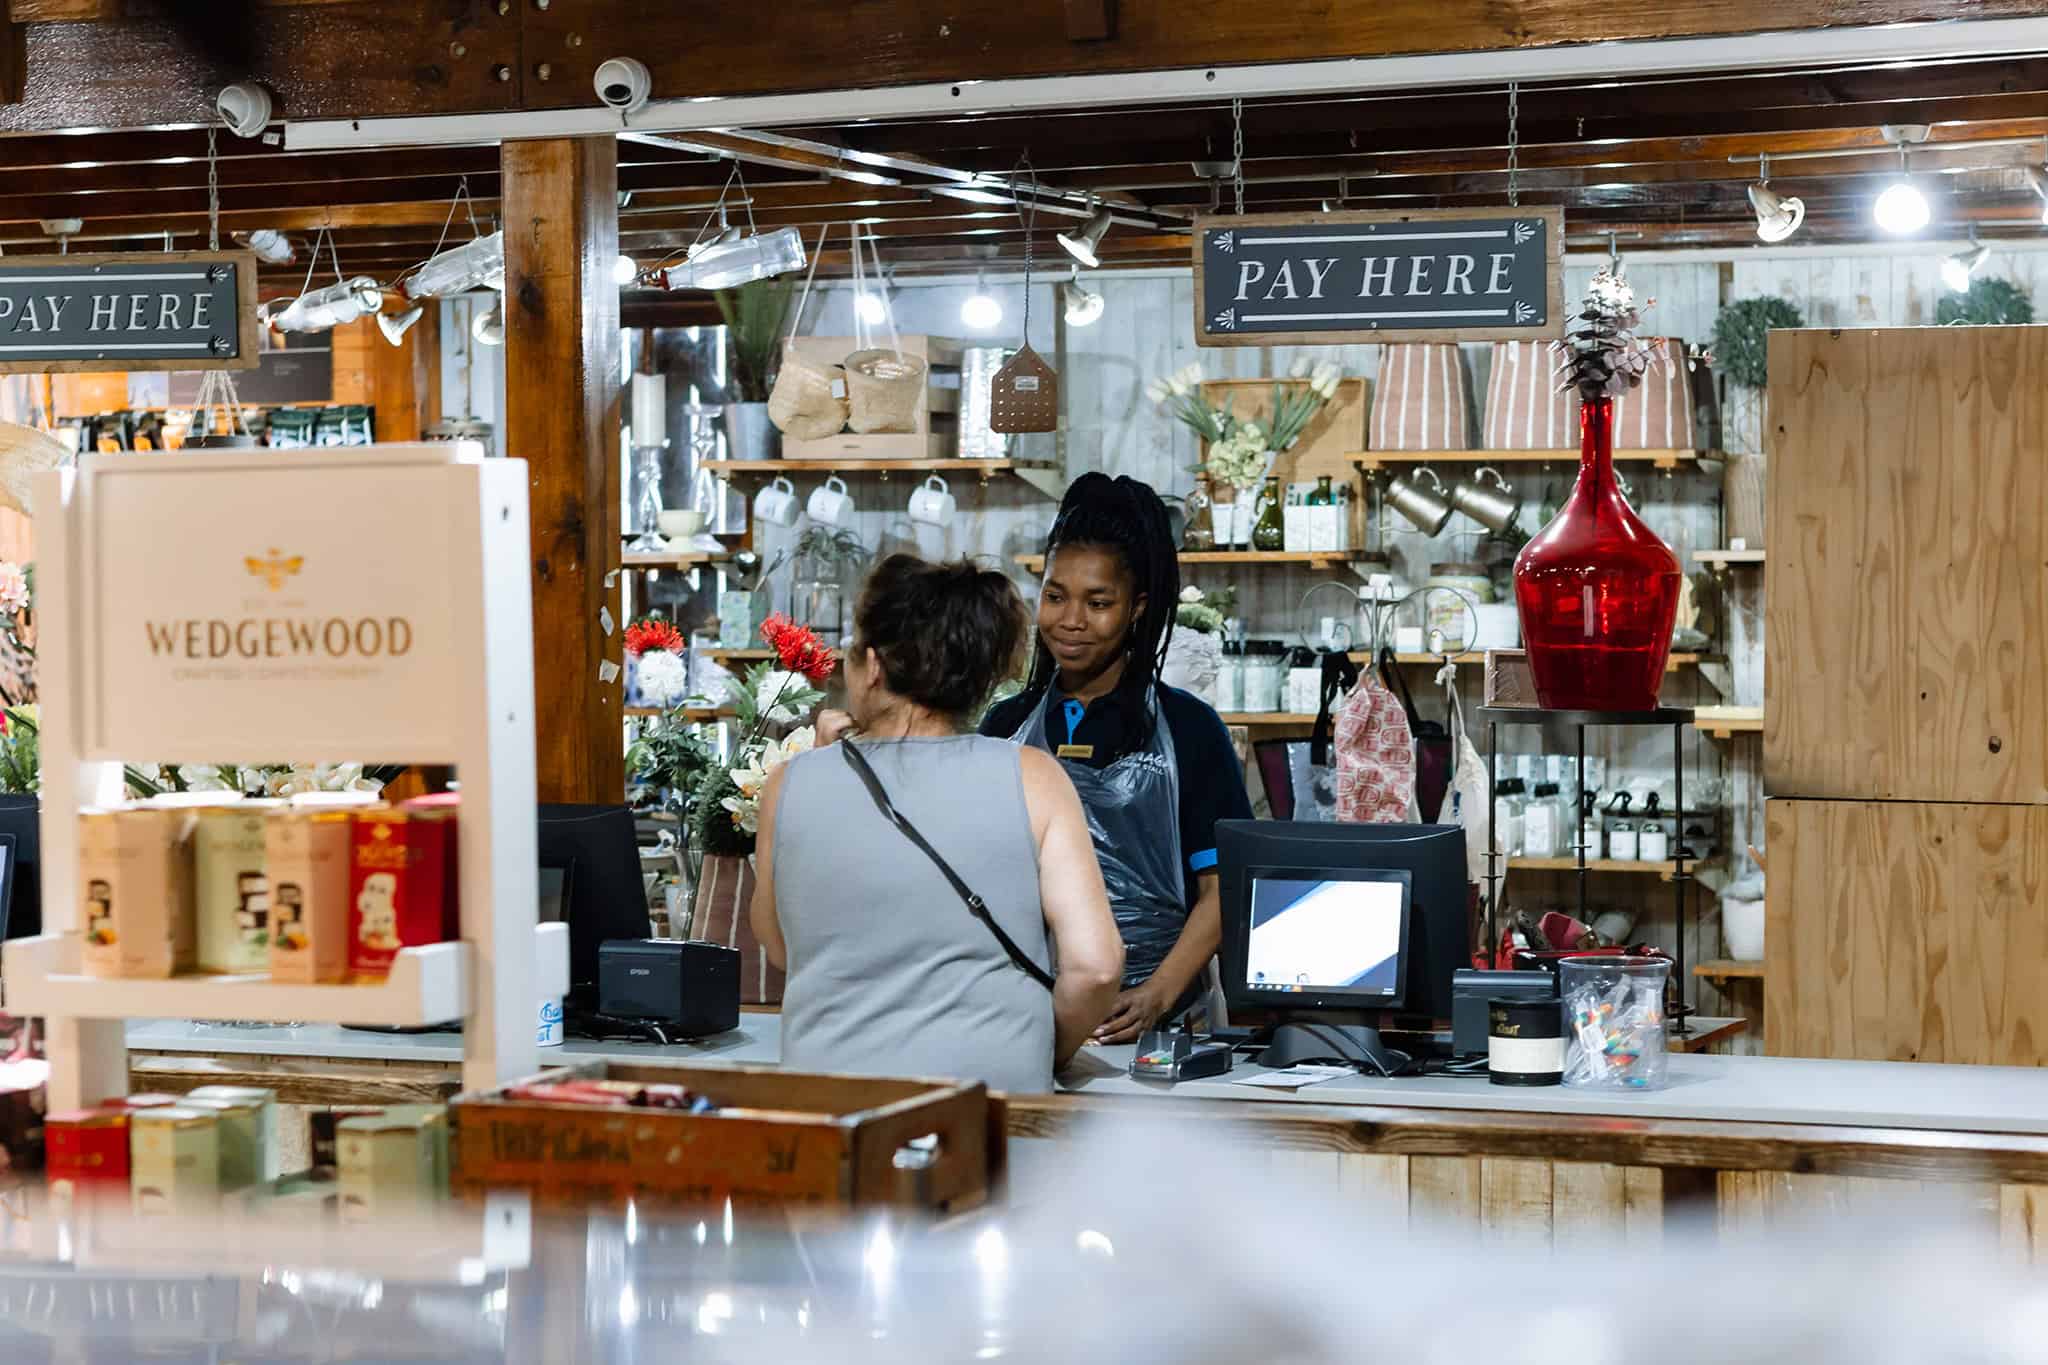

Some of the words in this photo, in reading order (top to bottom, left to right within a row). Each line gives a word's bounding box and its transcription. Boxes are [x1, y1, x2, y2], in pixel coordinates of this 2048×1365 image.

[1233, 257, 1341, 300] PAY
[1357, 253, 1516, 297] HERE
[90, 292, 213, 330] HERE
[145, 616, 413, 658] WEDGEWOOD
